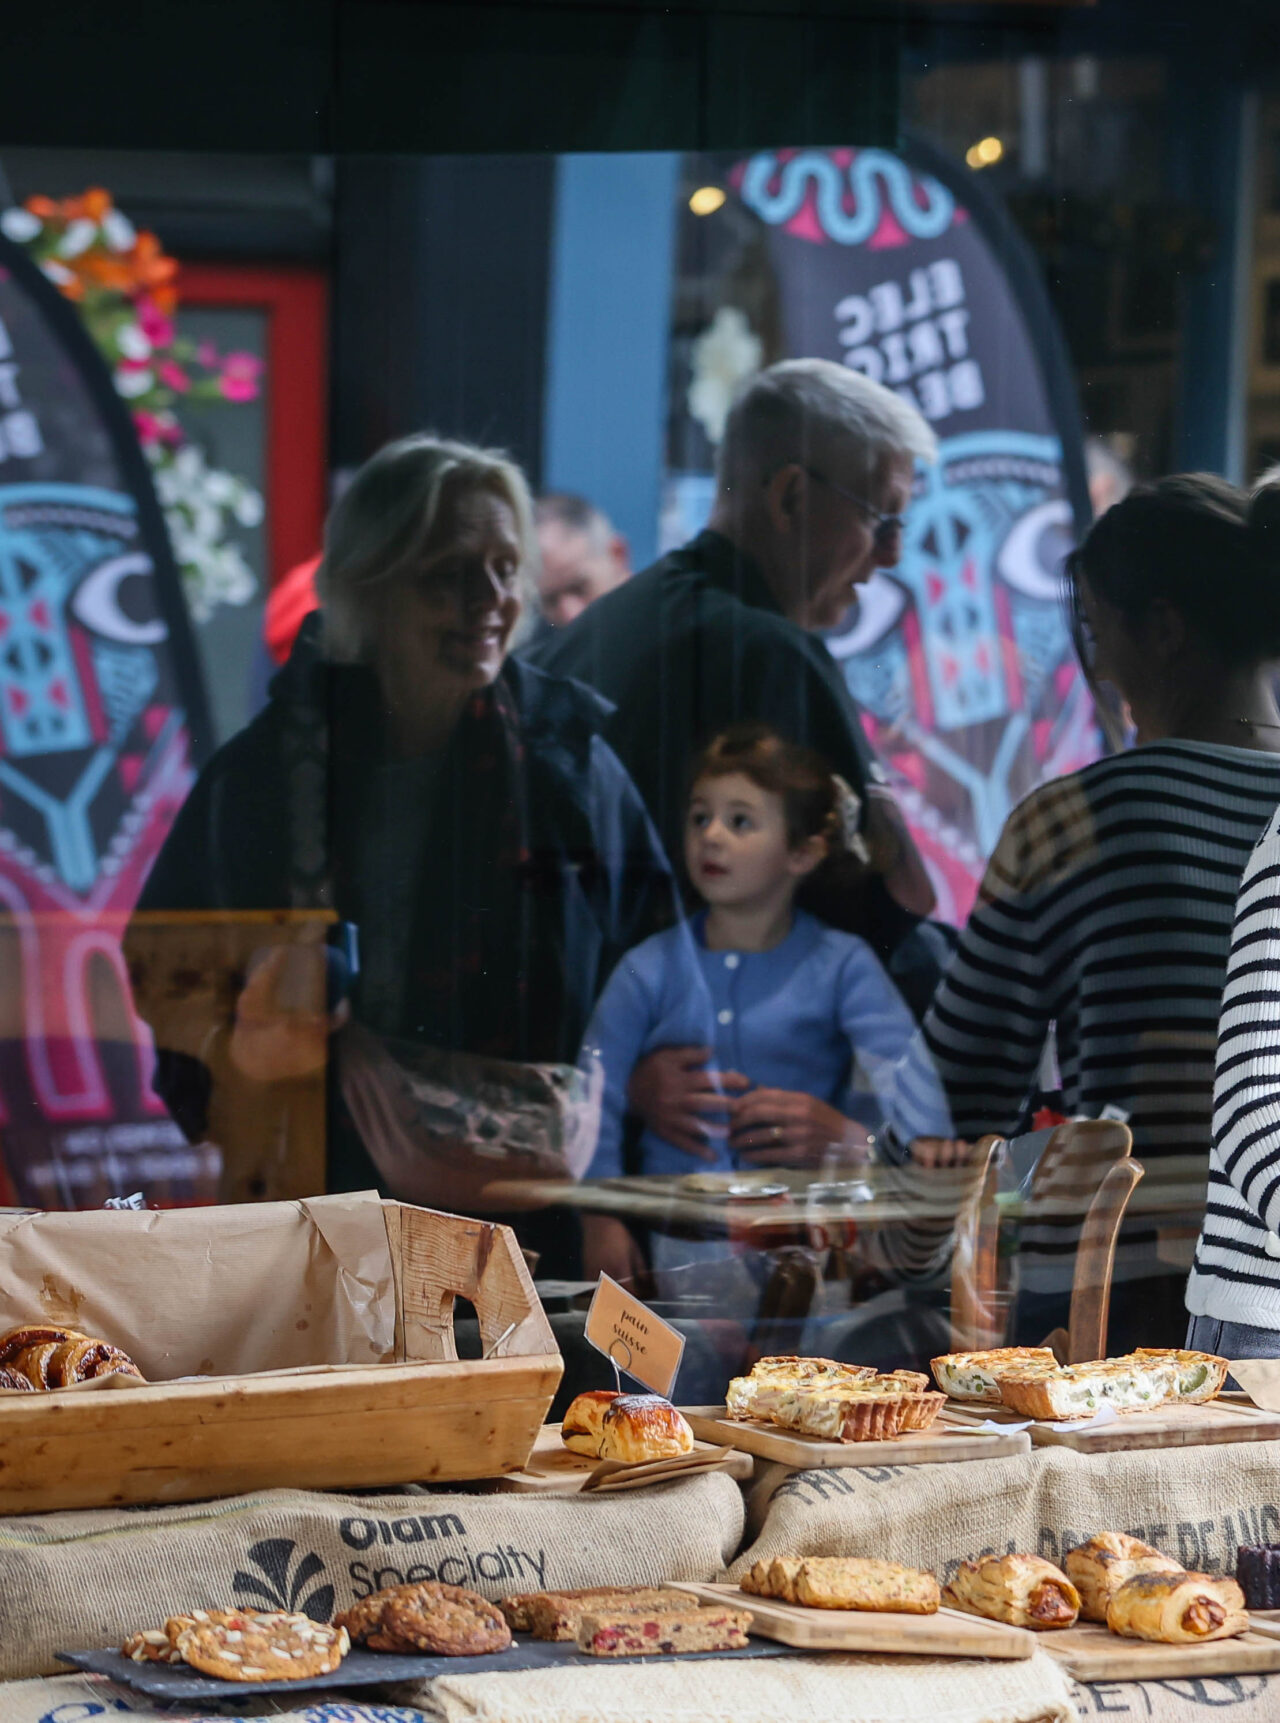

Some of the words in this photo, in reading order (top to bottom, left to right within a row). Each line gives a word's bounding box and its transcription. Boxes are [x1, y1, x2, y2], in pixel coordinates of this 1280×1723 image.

[613, 1323, 648, 1355] suisse
[621, 1310, 649, 1335] pain
[340, 1513, 467, 1551] Olam
[350, 1544, 547, 1599] Specialty
